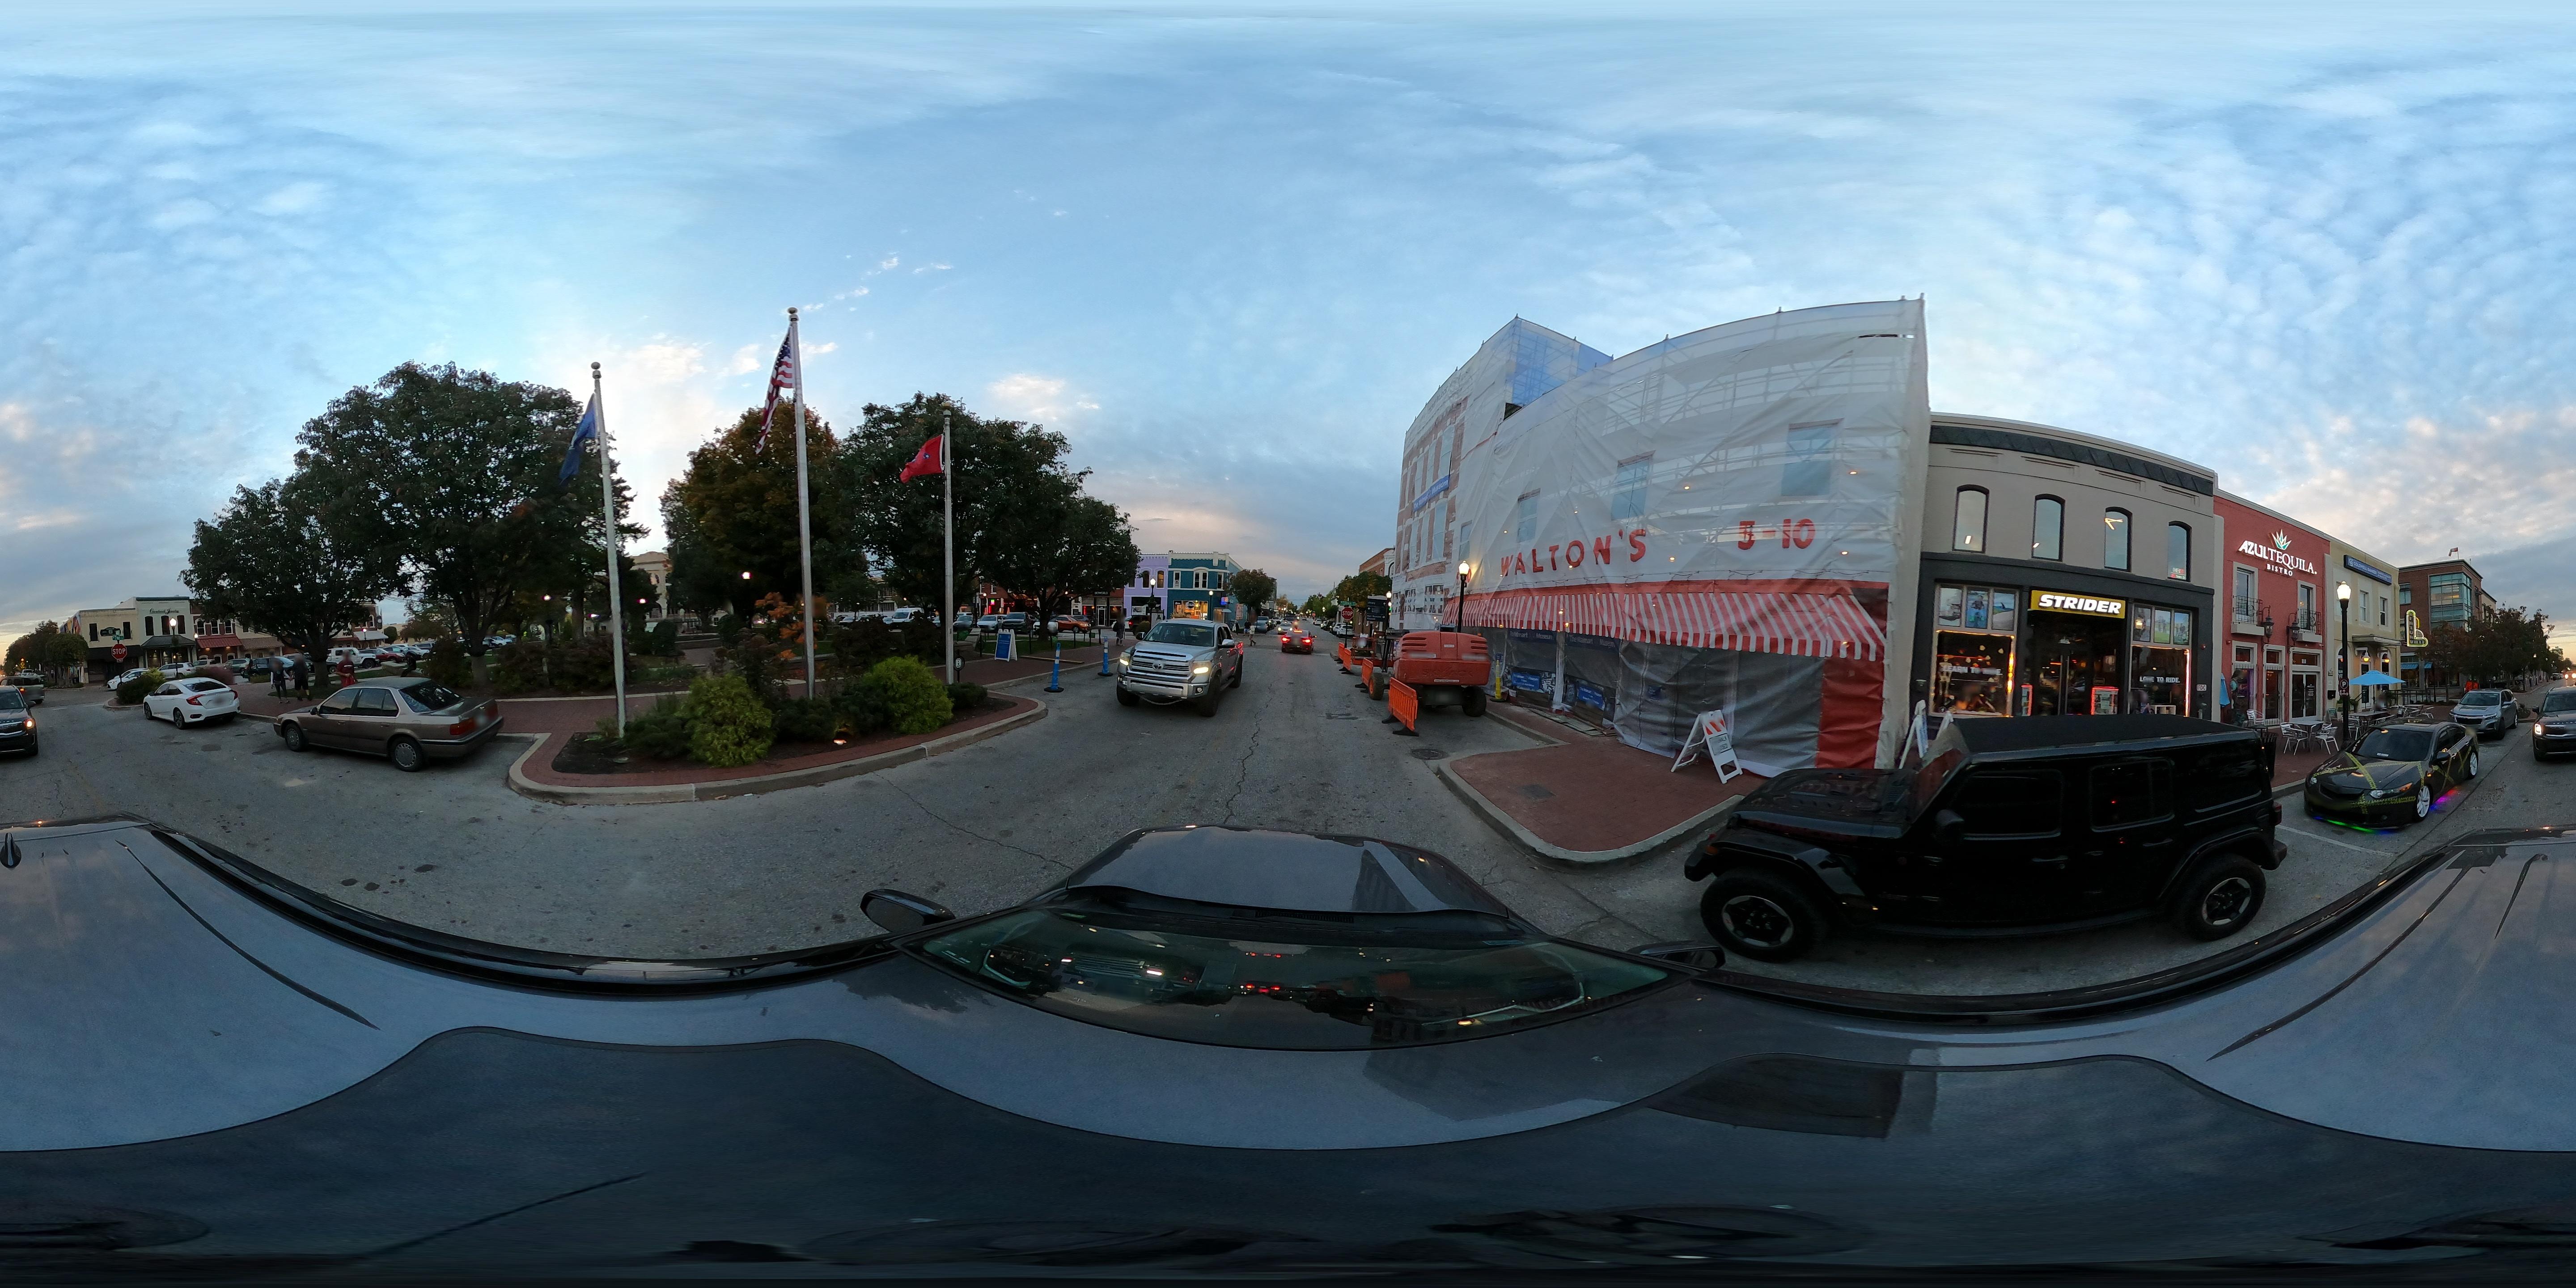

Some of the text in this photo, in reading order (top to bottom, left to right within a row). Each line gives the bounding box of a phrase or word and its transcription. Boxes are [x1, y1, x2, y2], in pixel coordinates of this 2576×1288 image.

[1501, 529, 1646, 576] WALTON'S
[2267, 564, 2293, 576] BISTRO
[2038, 594, 2122, 614] STRIDER
